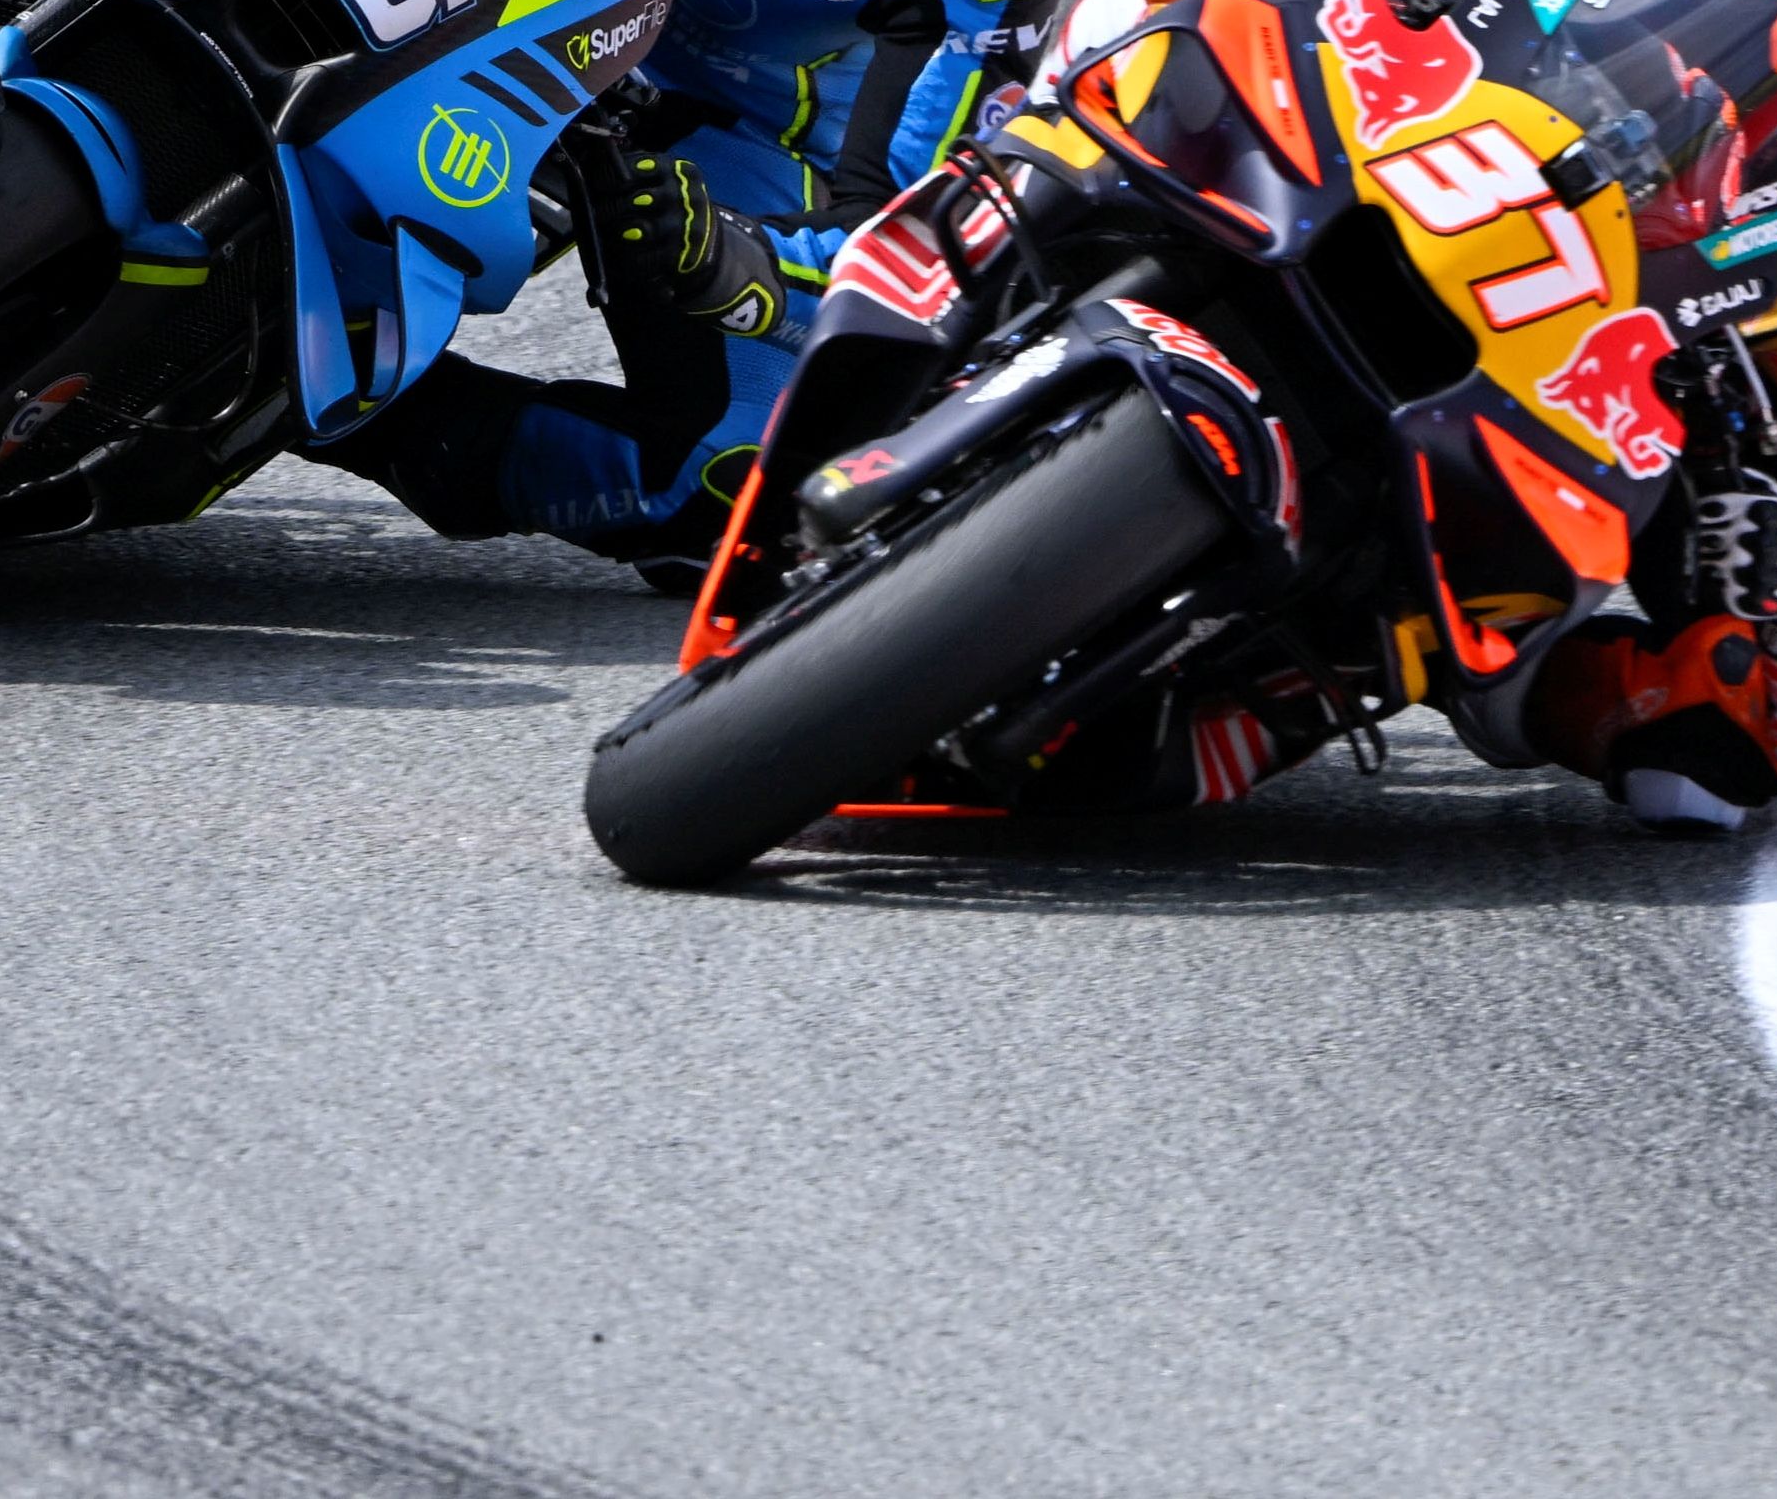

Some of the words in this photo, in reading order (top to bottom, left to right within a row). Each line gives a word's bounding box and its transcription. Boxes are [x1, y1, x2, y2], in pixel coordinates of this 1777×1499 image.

[1364, 119, 1612, 334] 37
[1702, 278, 1763, 319] BAJAJ
[1186, 412, 1242, 477] KTM
